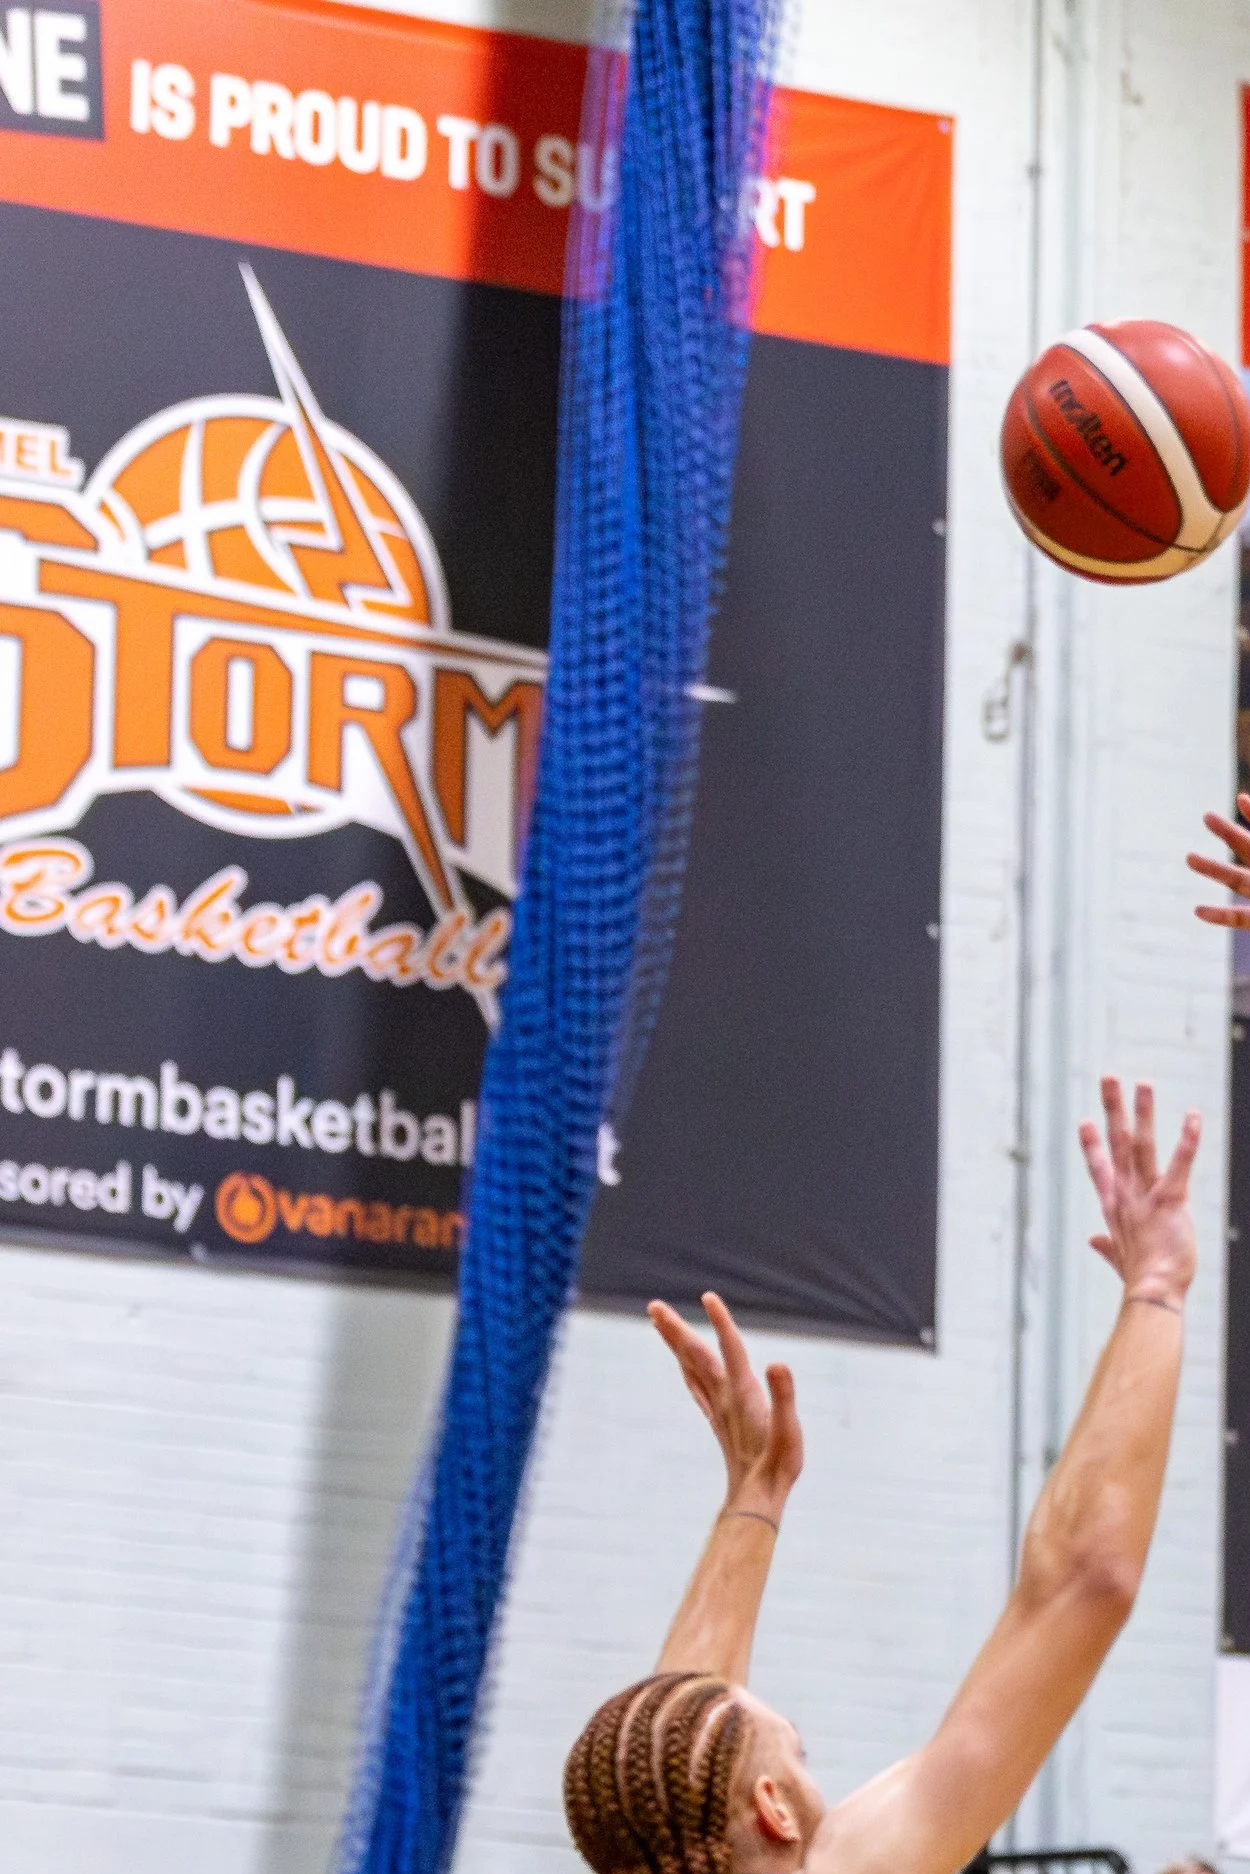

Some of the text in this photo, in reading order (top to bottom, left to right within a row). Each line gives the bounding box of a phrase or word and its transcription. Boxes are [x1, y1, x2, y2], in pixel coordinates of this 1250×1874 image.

[129, 60, 195, 142] IS
[211, 71, 428, 182] PROUD
[437, 115, 520, 197] TO
[534, 133, 818, 251] SURT
[0, 842, 512, 988] Basketball
[0, 1158, 466, 1249] sored by vanara
